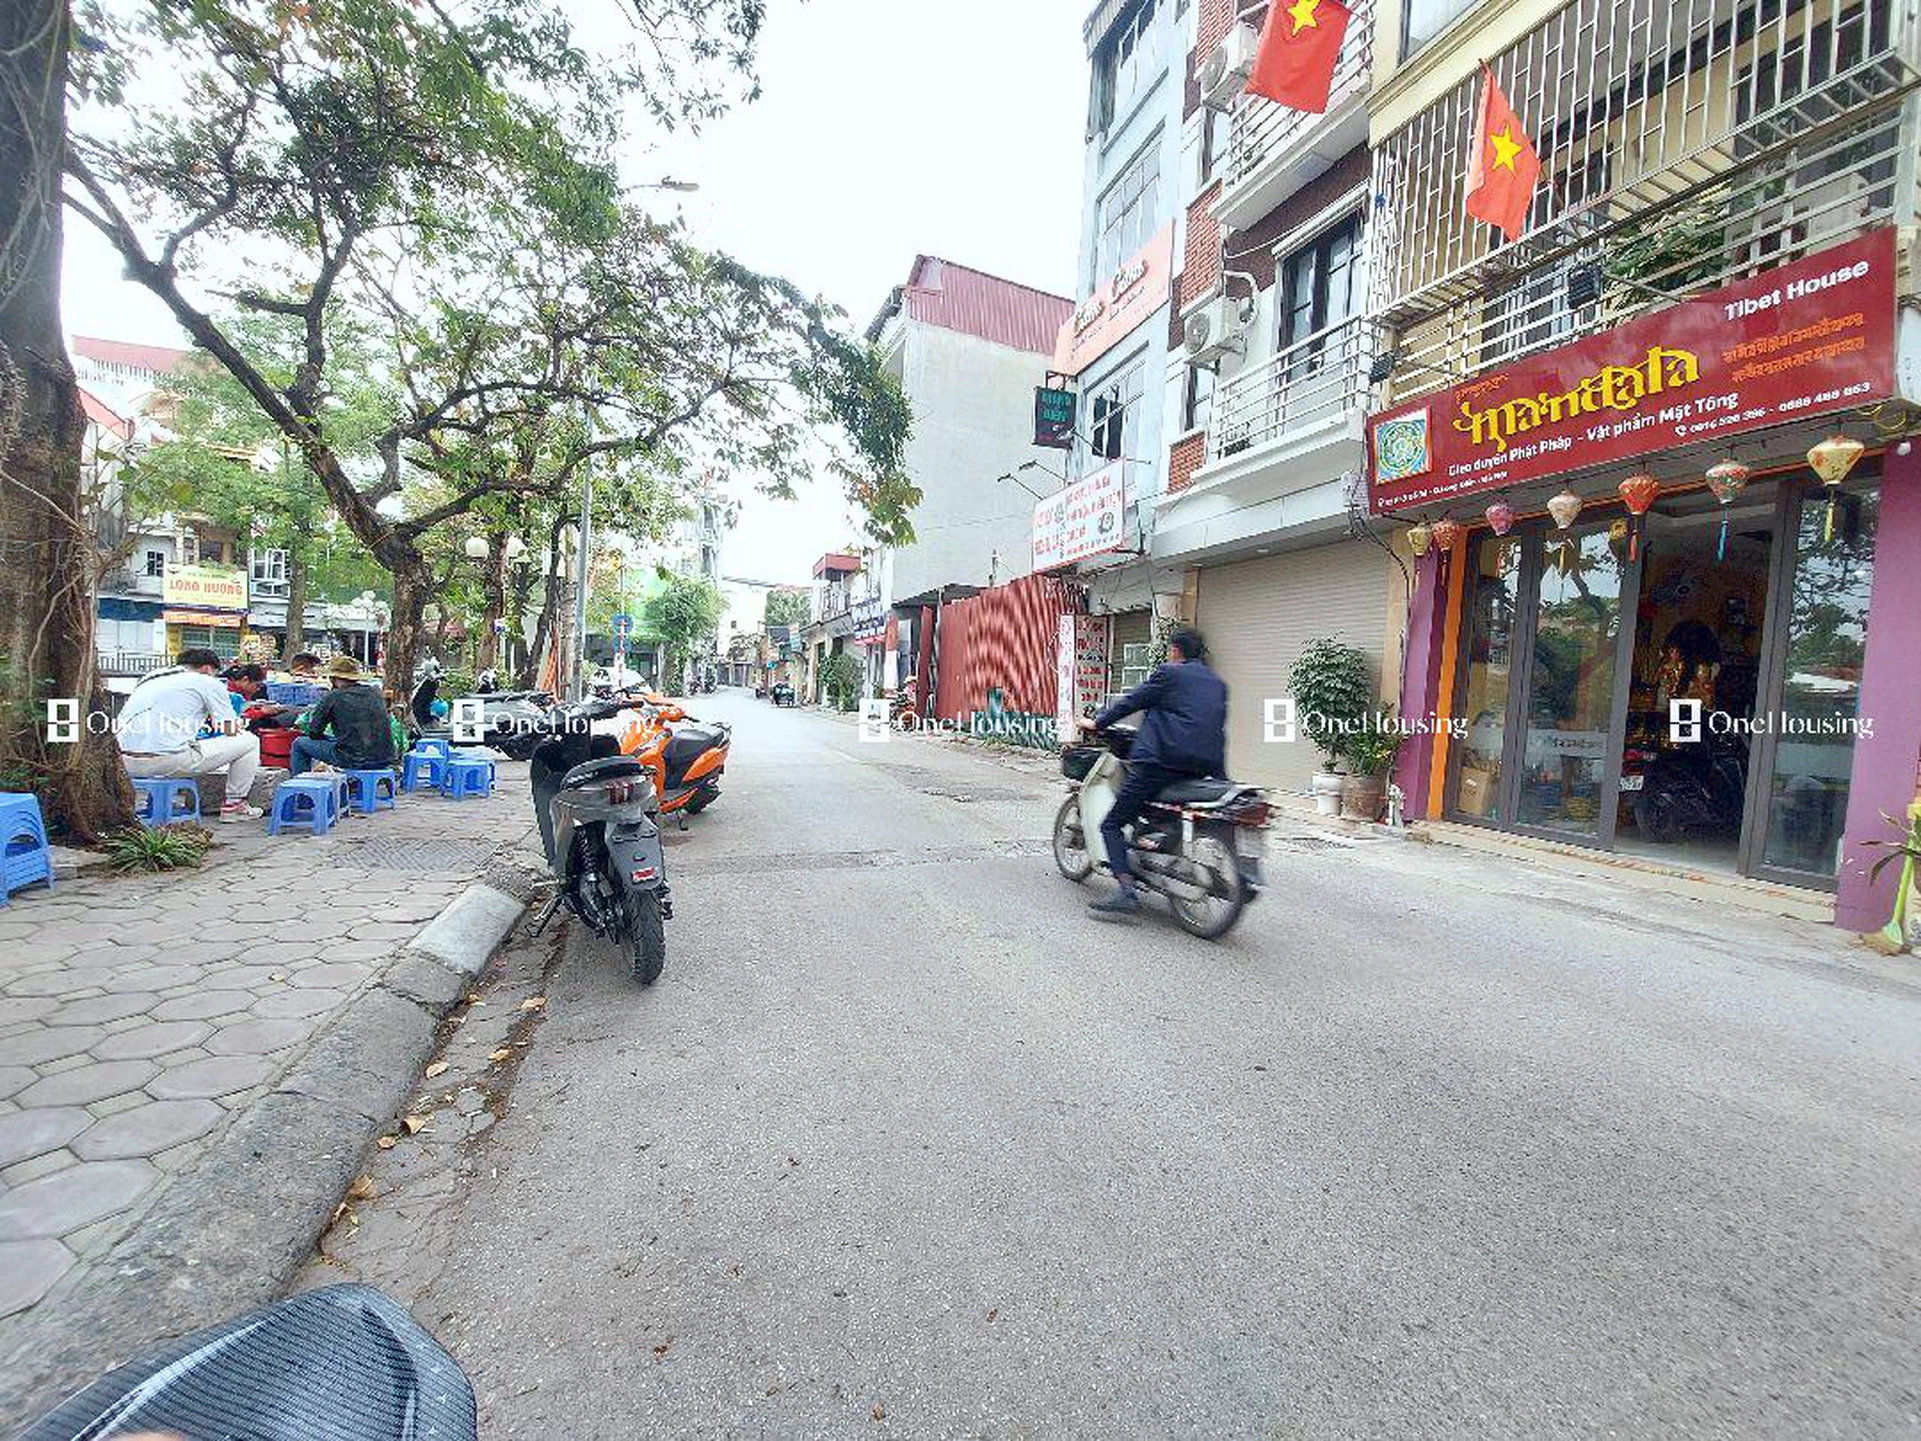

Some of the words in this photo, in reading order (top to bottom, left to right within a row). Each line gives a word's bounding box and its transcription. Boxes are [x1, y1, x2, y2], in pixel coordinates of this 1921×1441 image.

[1724, 289, 1782, 321] Tibet
[1786, 260, 1870, 300] House
[1539, 435, 1573, 455] Pháp
[1659, 403, 1692, 424] Mật
